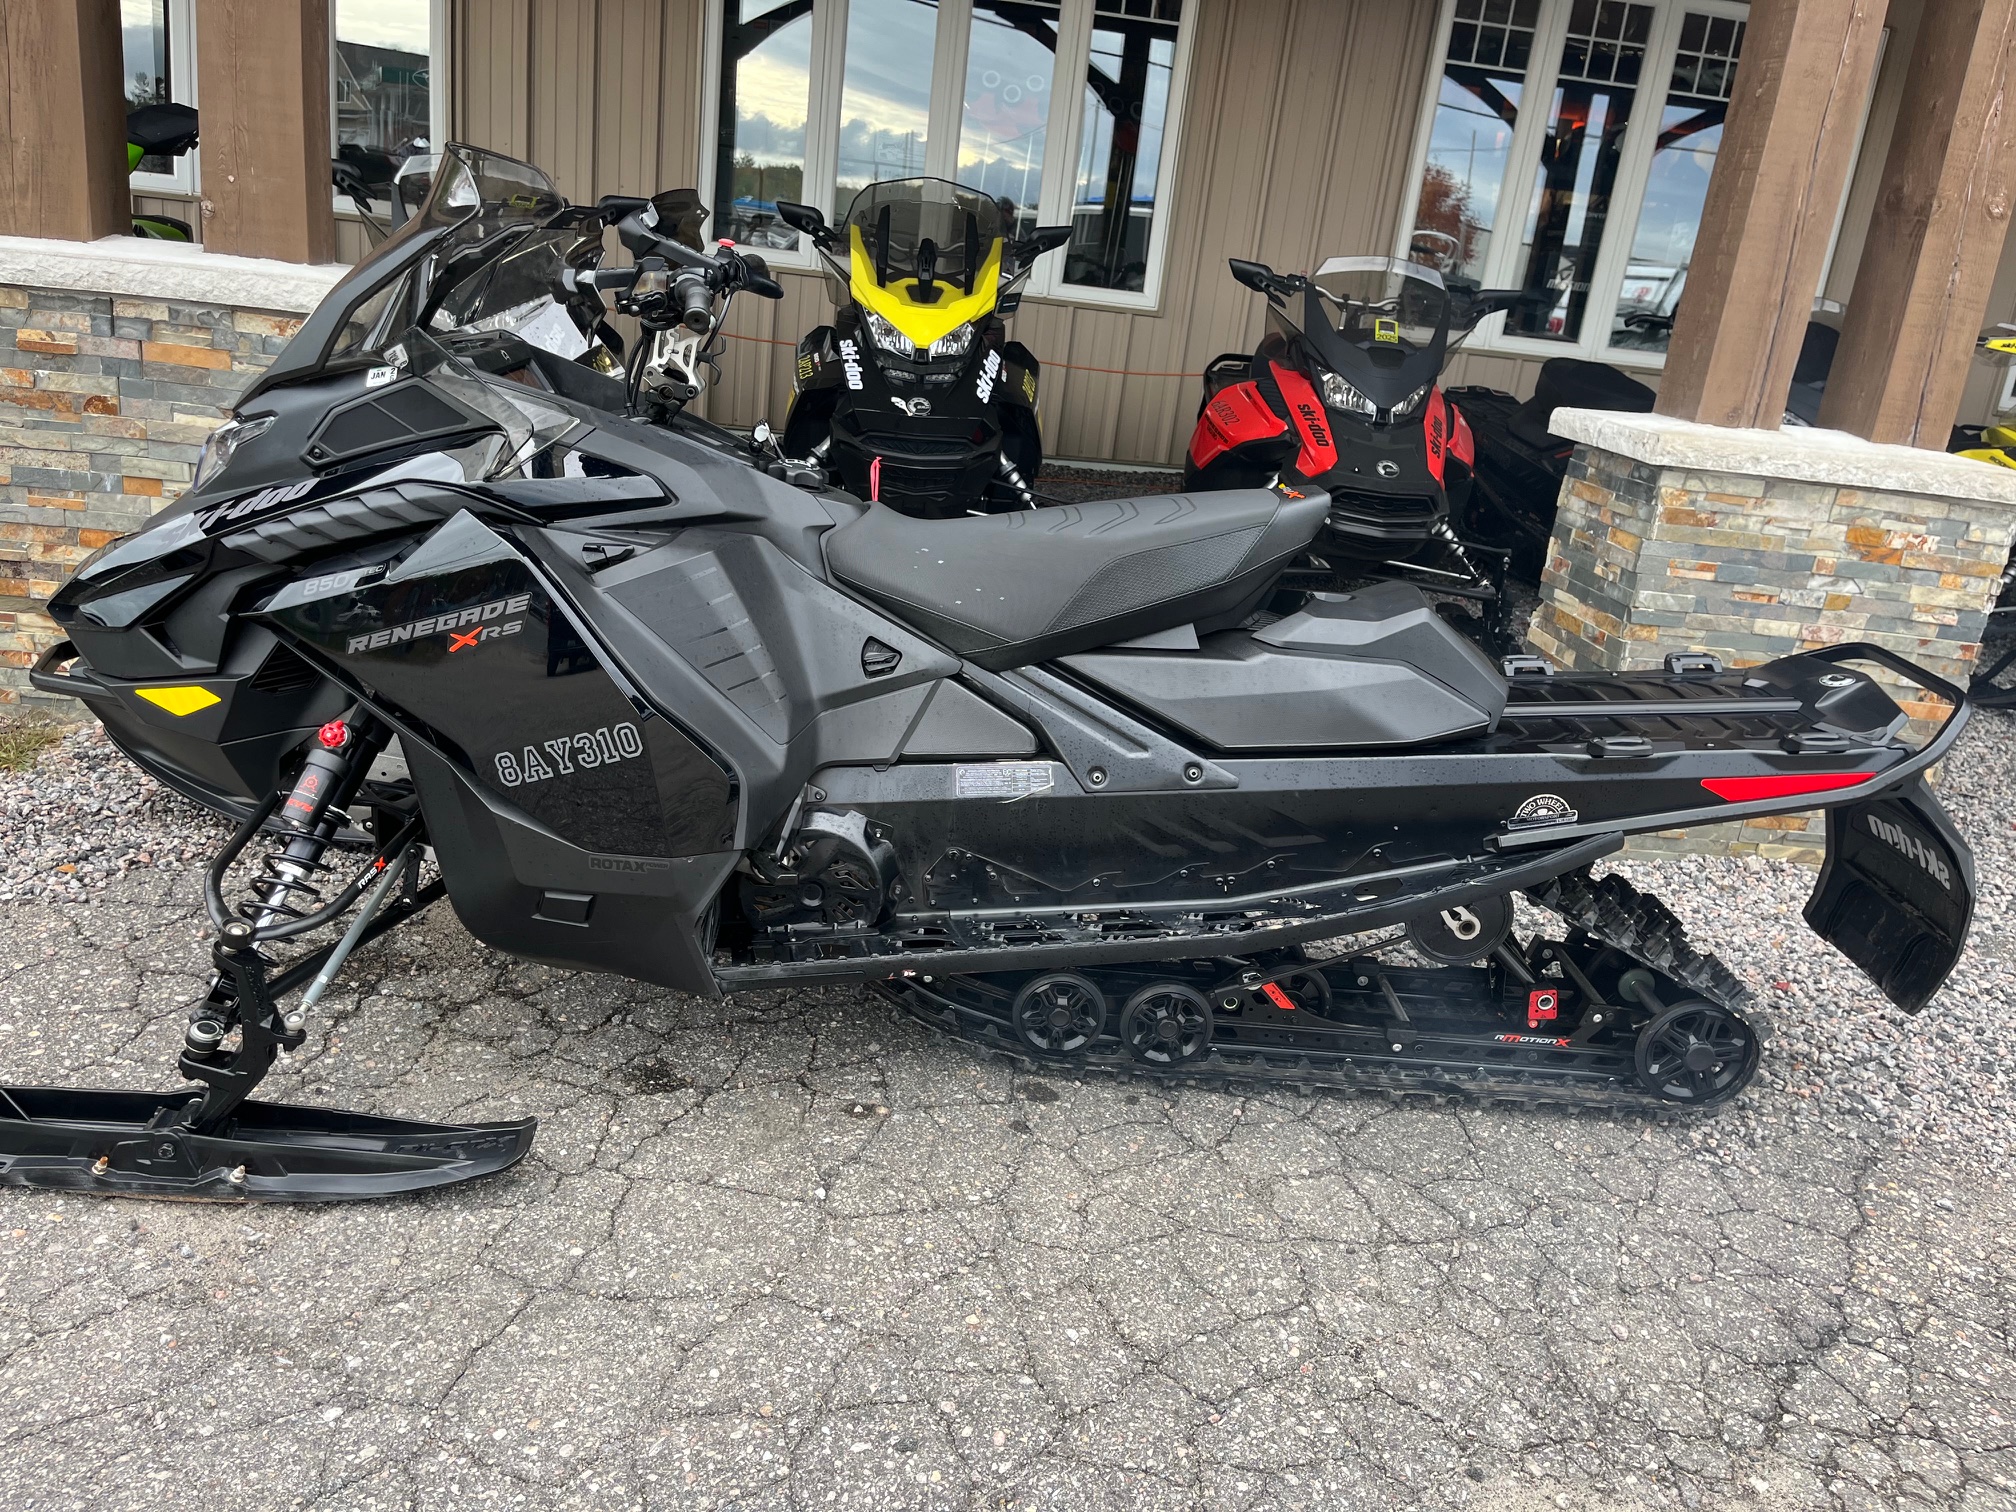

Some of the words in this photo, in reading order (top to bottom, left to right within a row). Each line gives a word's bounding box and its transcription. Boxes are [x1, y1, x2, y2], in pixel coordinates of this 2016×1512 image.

[1377, 333, 1397, 342] 2025
[371, 371, 386, 380] JAN
[840, 339, 863, 390] ski-doo
[976, 349, 1001, 404] ski-doo
[1298, 404, 1330, 447] ski-doo
[1430, 415, 1443, 459] ski-doo
[158, 478, 320, 550] ski-doo
[303, 573, 350, 596] 850
[348, 593, 532, 655] RENEGADE
[494, 721, 644, 787] 8AY310
[1520, 802, 1536, 818] TWO
[1536, 798, 1564, 813] WHEEL
[589, 857, 646, 873] ROTAX
